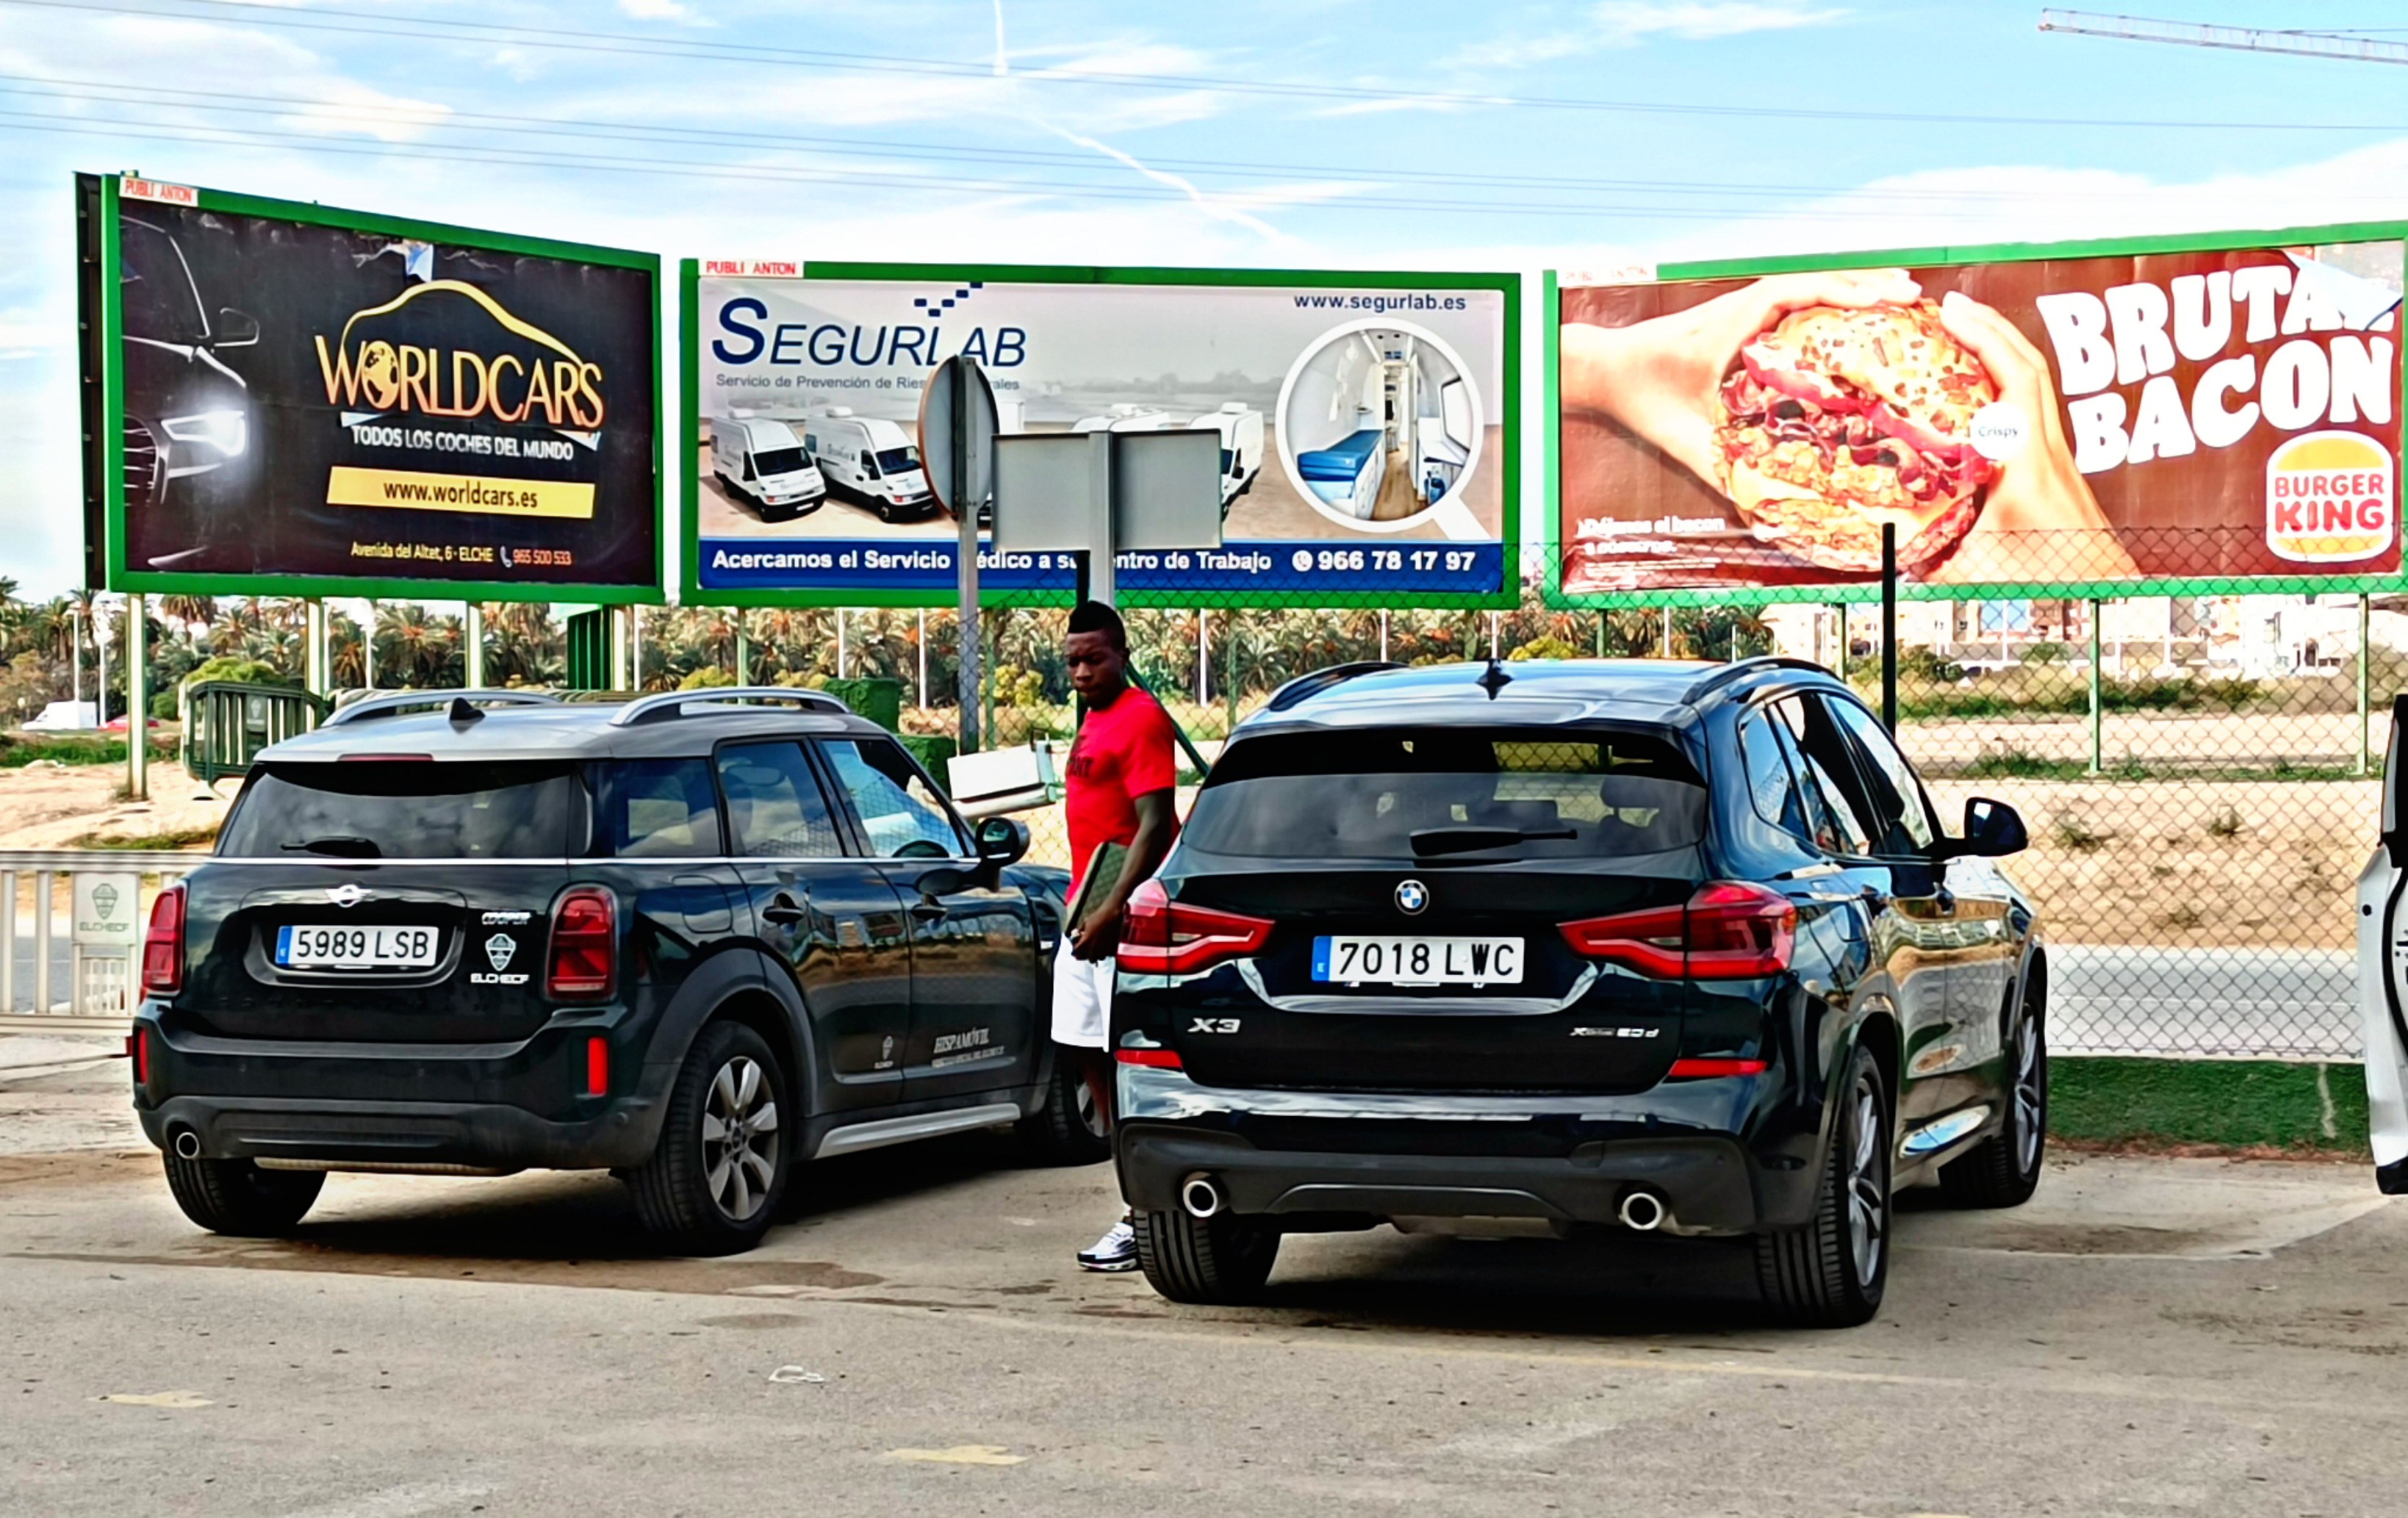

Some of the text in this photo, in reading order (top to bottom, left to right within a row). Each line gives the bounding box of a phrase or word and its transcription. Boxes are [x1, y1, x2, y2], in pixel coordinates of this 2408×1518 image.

[124, 179, 193, 202] PUBLI ANTON
[705, 260, 796, 275] PUBLI ANTON
[1293, 293, 1467, 314] www.segurlab.es
[2035, 265, 2394, 395] BRUTA
[314, 334, 605, 428] WORLDCARS
[715, 373, 771, 388] Servicio
[774, 375, 793, 388] de
[796, 375, 871, 389] Prevención
[874, 376, 892, 389] de
[2067, 335, 2393, 475] BACON
[351, 425, 574, 461] TODOS LOS COCHES DEL MUNDO
[1977, 425, 2019, 439] Crispy
[383, 480, 539, 508] www.worldcars.es
[2274, 473, 2384, 498] BURGER
[2274, 498, 2385, 533] KING
[351, 541, 394, 558] Avenida
[395, 542, 412, 558] del
[459, 546, 495, 563] ELCHE
[711, 550, 833, 569] Acercamos
[838, 550, 858, 569] el
[864, 550, 952, 569] Servicio
[977, 550, 1032, 569] édico
[1038, 554, 1052, 569] a
[1164, 552, 1190, 570] de
[1196, 551, 1272, 574] Trabajo
[1318, 550, 1476, 572] 966 78 17 97
[296, 929, 429, 959] 5989 LSB
[1339, 942, 1514, 976] 7018 LWC
[1187, 1017, 1241, 1034] X3
